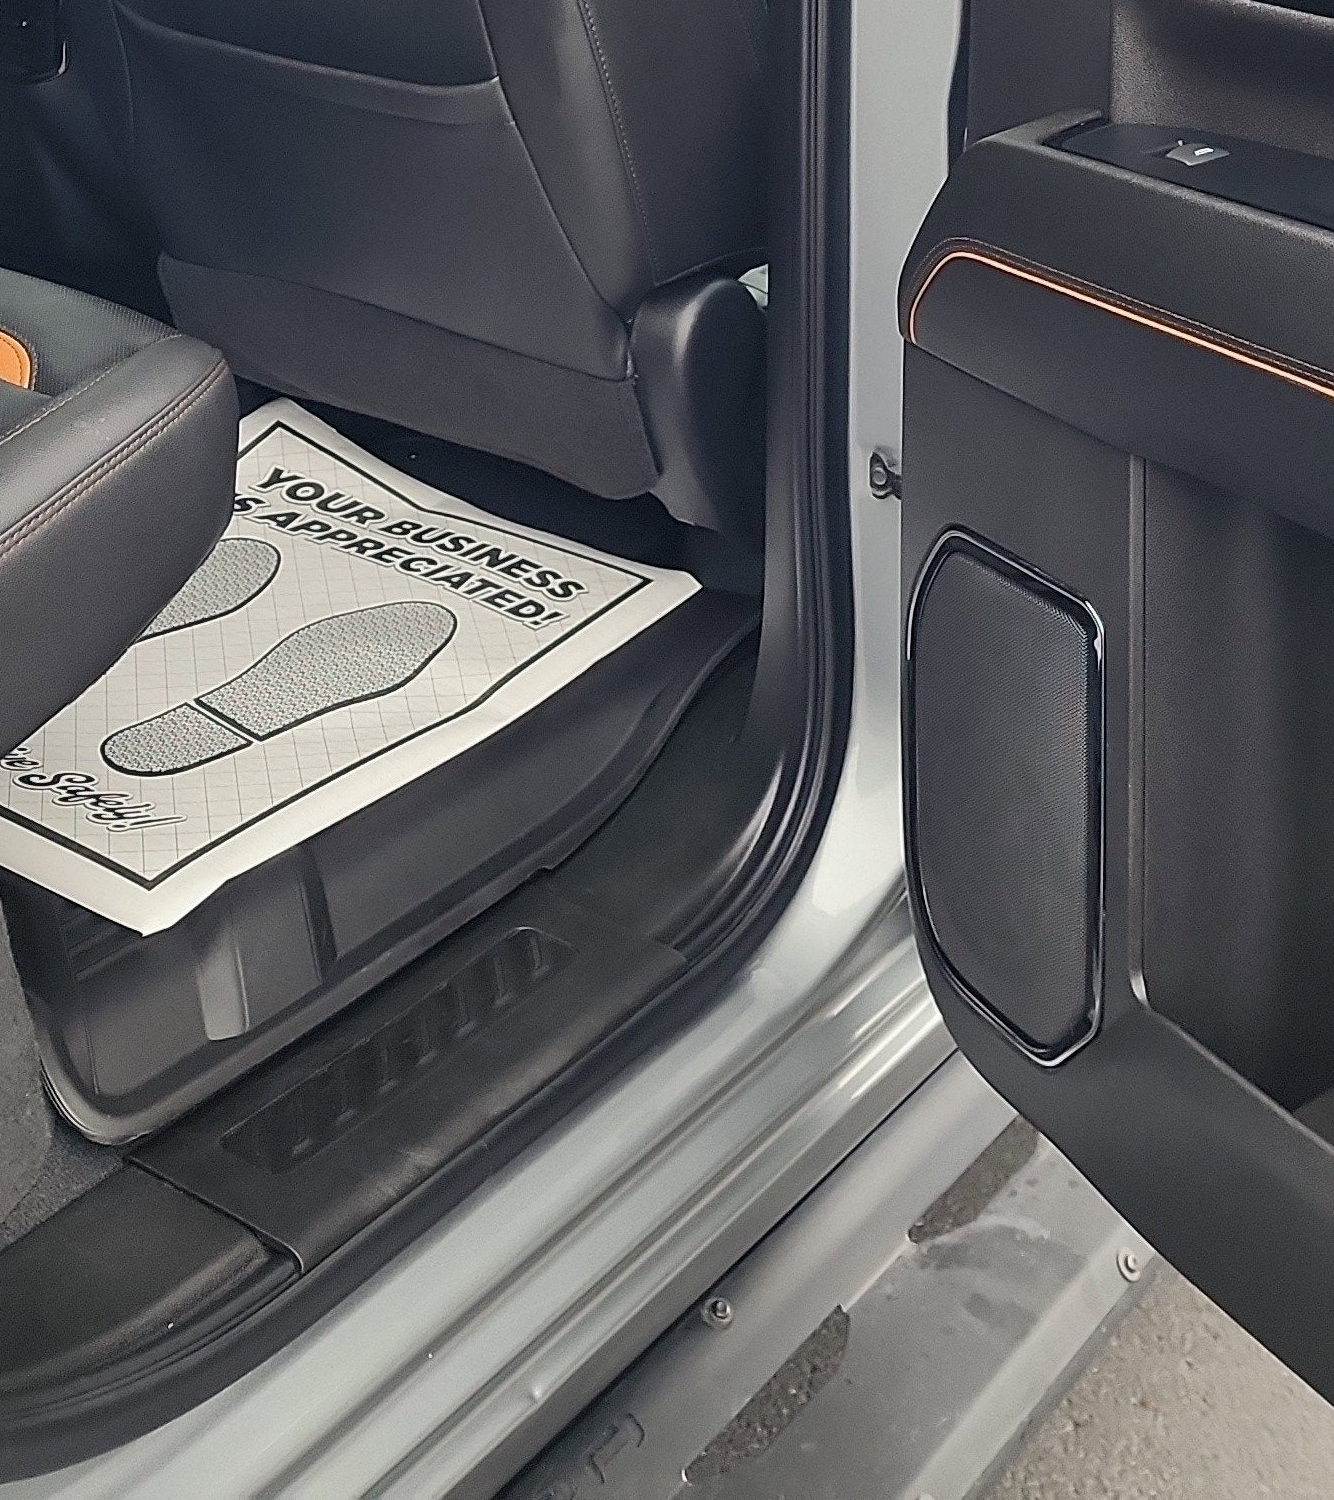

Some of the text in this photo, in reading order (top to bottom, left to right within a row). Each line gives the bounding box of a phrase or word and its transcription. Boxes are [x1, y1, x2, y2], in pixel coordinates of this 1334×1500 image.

[234, 493, 565, 626] S APPRECIATED!
[255, 467, 586, 599] YOUR BUSINESS
[17, 772, 186, 828] Safely!
